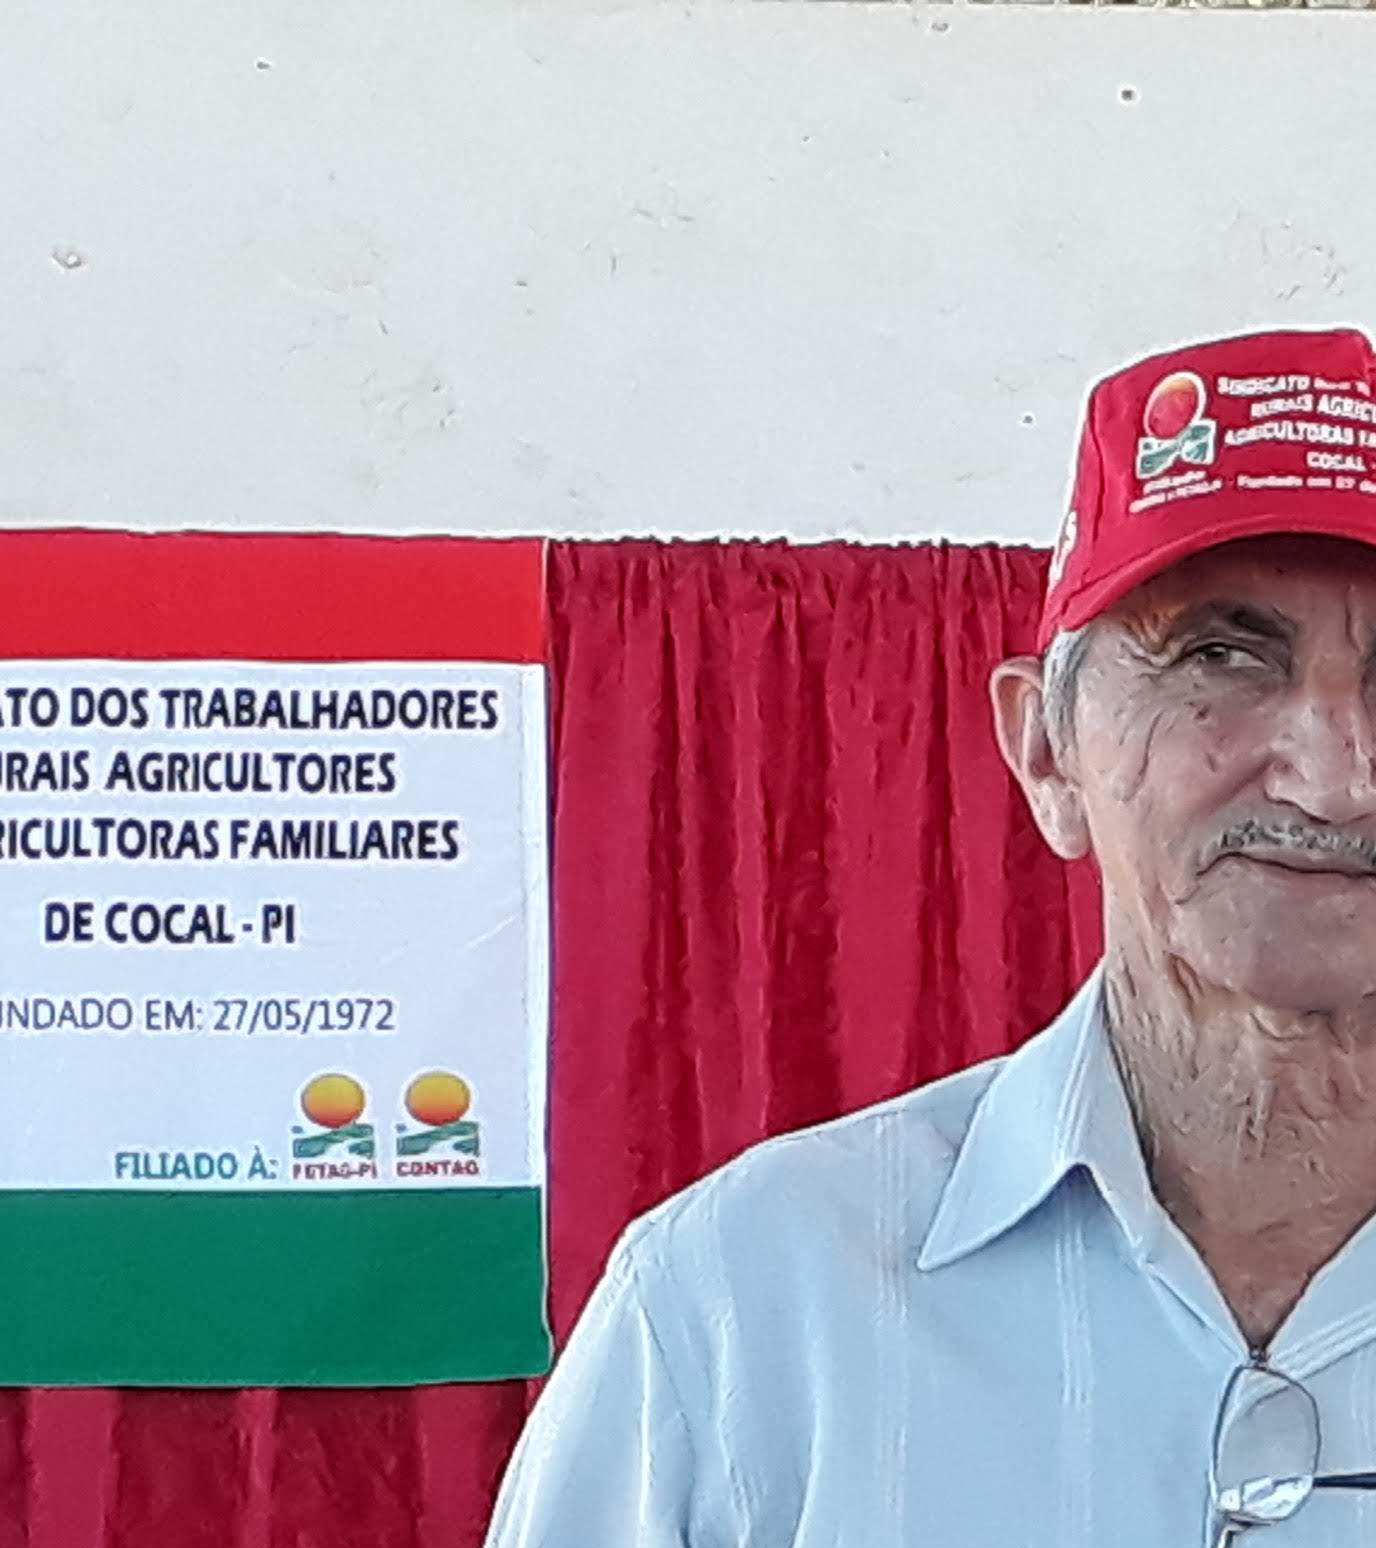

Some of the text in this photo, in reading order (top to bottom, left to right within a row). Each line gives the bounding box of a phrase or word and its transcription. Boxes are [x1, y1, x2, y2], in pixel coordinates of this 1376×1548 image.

[0, 687, 498, 729] TO DOS TRABALHADORES
[0, 750, 396, 793] RAIS AGRICULTORES
[231, 819, 459, 860] FAMILIARES
[45, 902, 94, 943] DE
[105, 903, 234, 943] COCAL
[262, 904, 295, 943] PI
[0, 998, 395, 1034] NDADO EM: 27/05/1972
[115, 1146, 277, 1179] FILIADO À:
